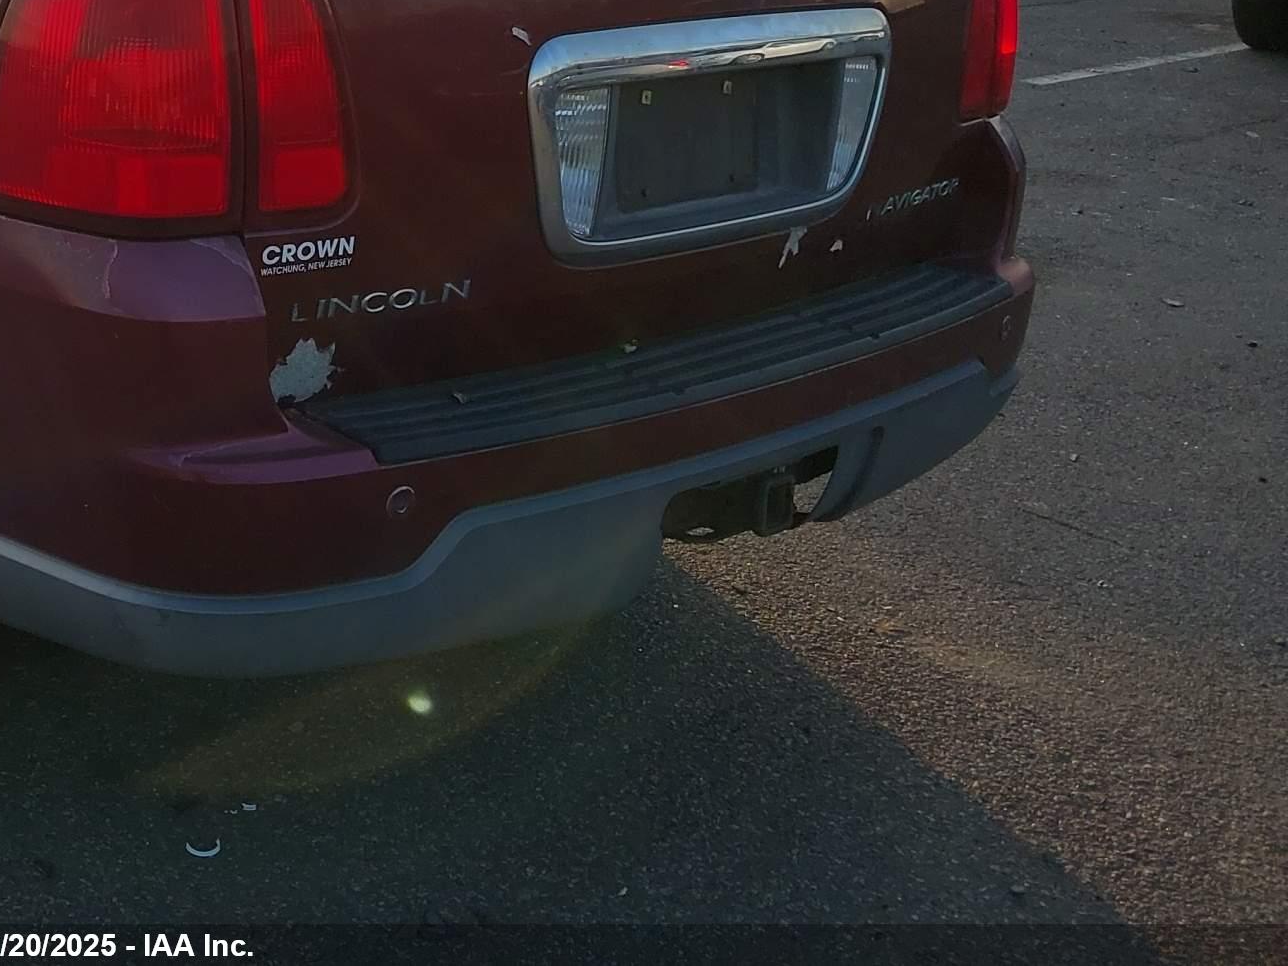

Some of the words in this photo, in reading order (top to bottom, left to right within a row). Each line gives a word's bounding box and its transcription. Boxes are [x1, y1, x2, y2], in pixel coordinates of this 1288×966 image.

[262, 236, 355, 265] CROWN
[260, 263, 307, 276] WATCHUNG,
[307, 261, 328, 271] NEW
[325, 257, 352, 269] JERSEY
[291, 279, 472, 322] LINCOLN
